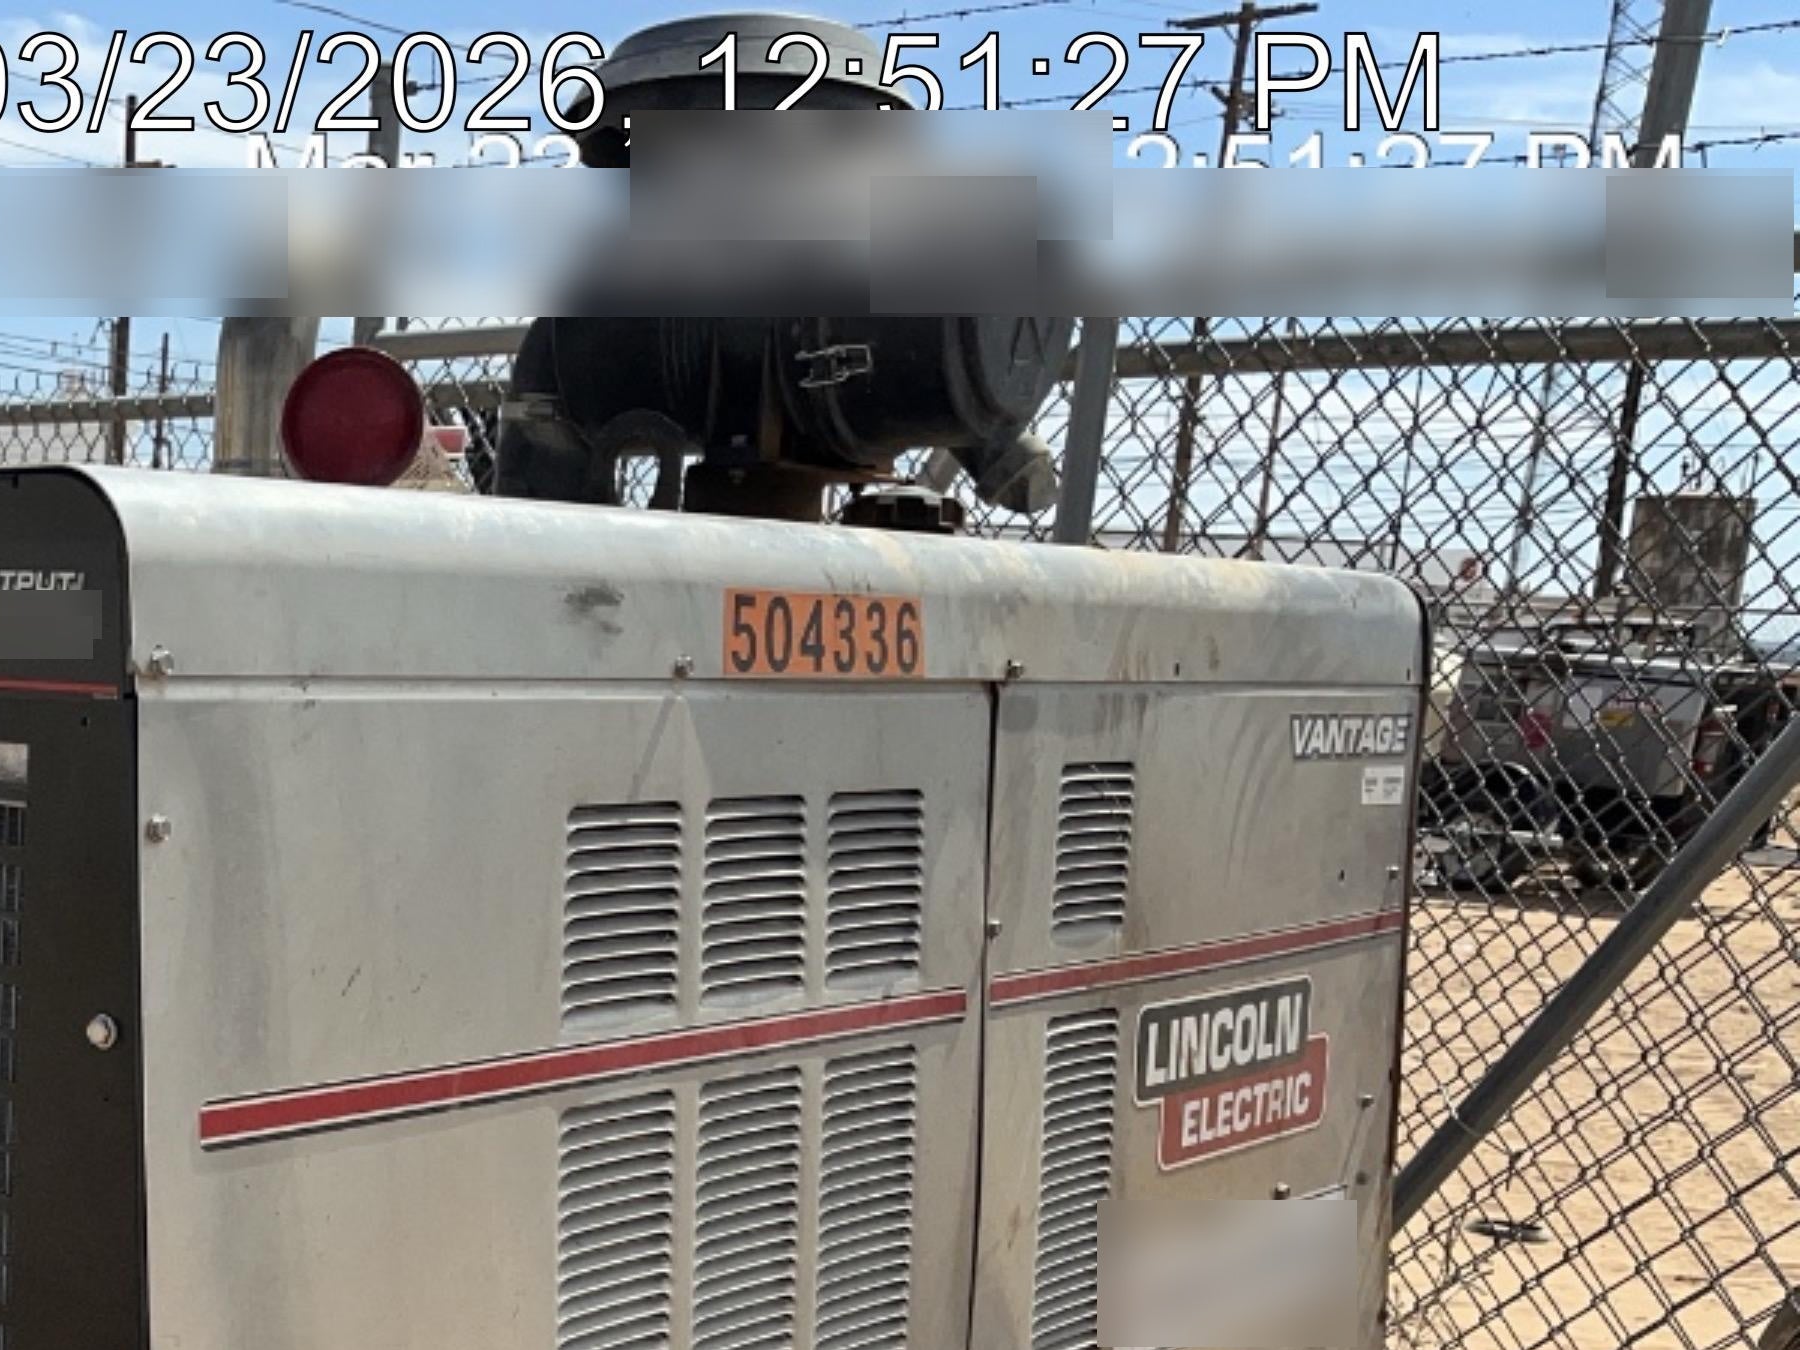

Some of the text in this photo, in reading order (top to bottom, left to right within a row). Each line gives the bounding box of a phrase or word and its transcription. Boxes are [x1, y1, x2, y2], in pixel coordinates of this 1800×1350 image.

[731, 593, 918, 673] 504336
[1290, 715, 1410, 757] VANTAGE
[1145, 992, 1303, 1087] LINCOLN
[1181, 1071, 1312, 1148] ELECTRIC
